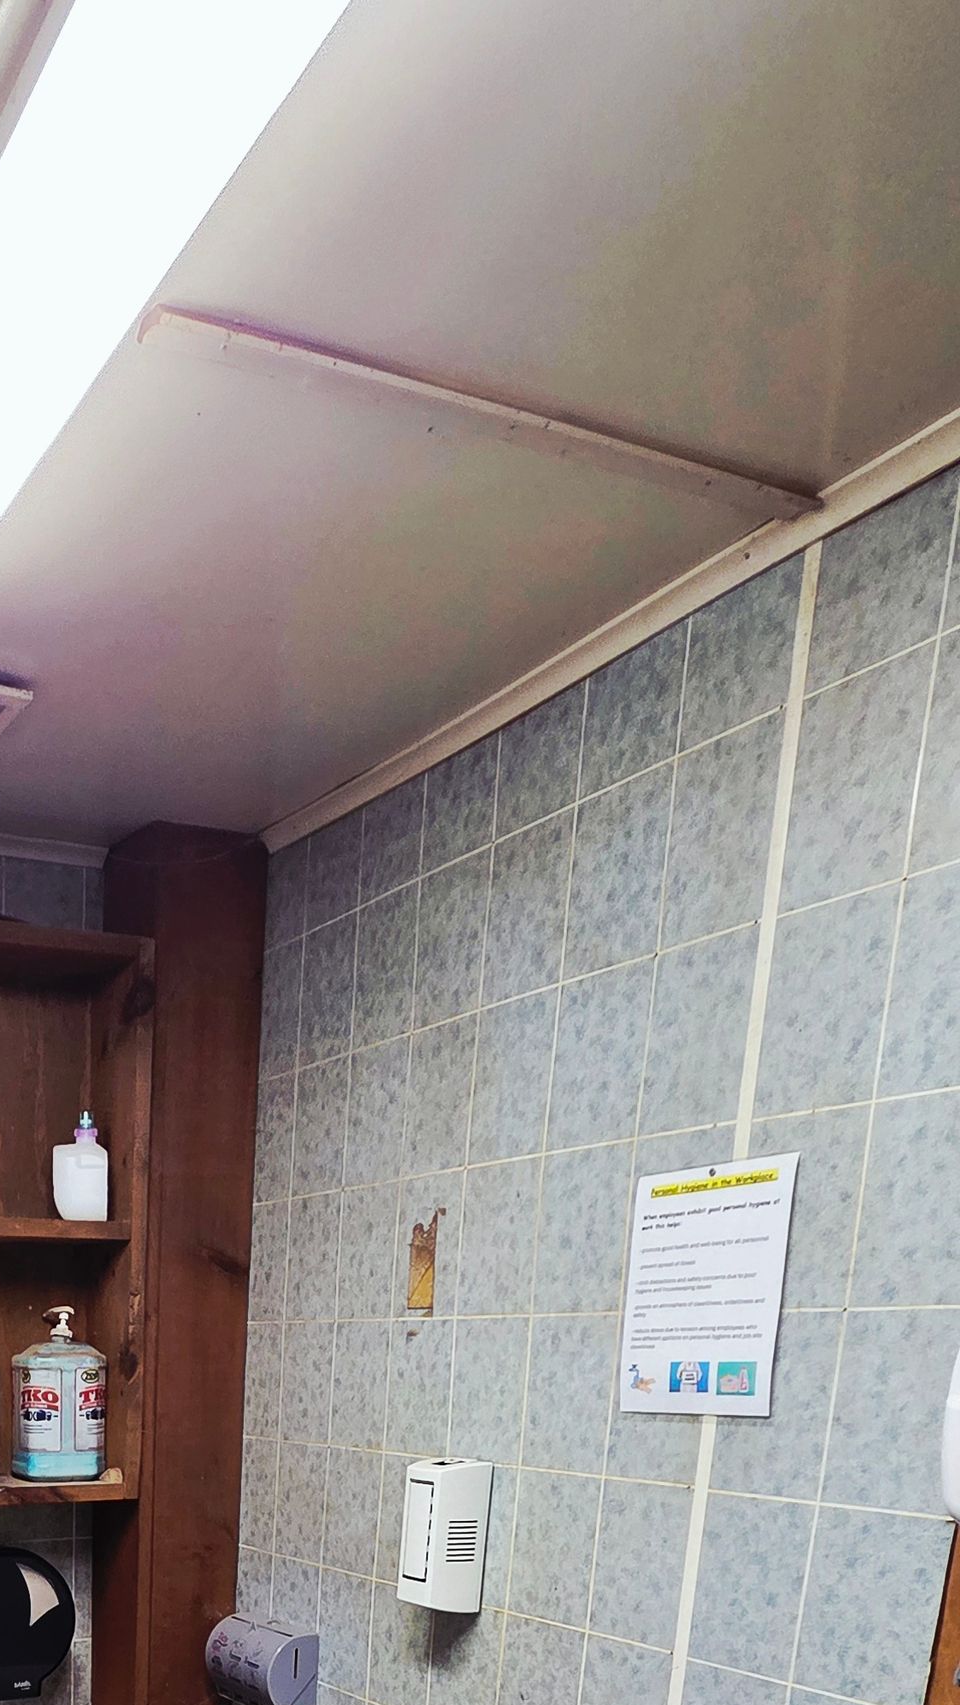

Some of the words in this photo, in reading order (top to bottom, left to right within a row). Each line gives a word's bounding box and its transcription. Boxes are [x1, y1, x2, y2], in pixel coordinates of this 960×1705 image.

[681, 1182, 709, 1193] Hygiene
[720, 1178, 732, 1186] the
[708, 1205, 721, 1214] good
[723, 1202, 746, 1212] personal
[21, 1389, 59, 1404] TKO
[79, 1388, 106, 1404] TK
